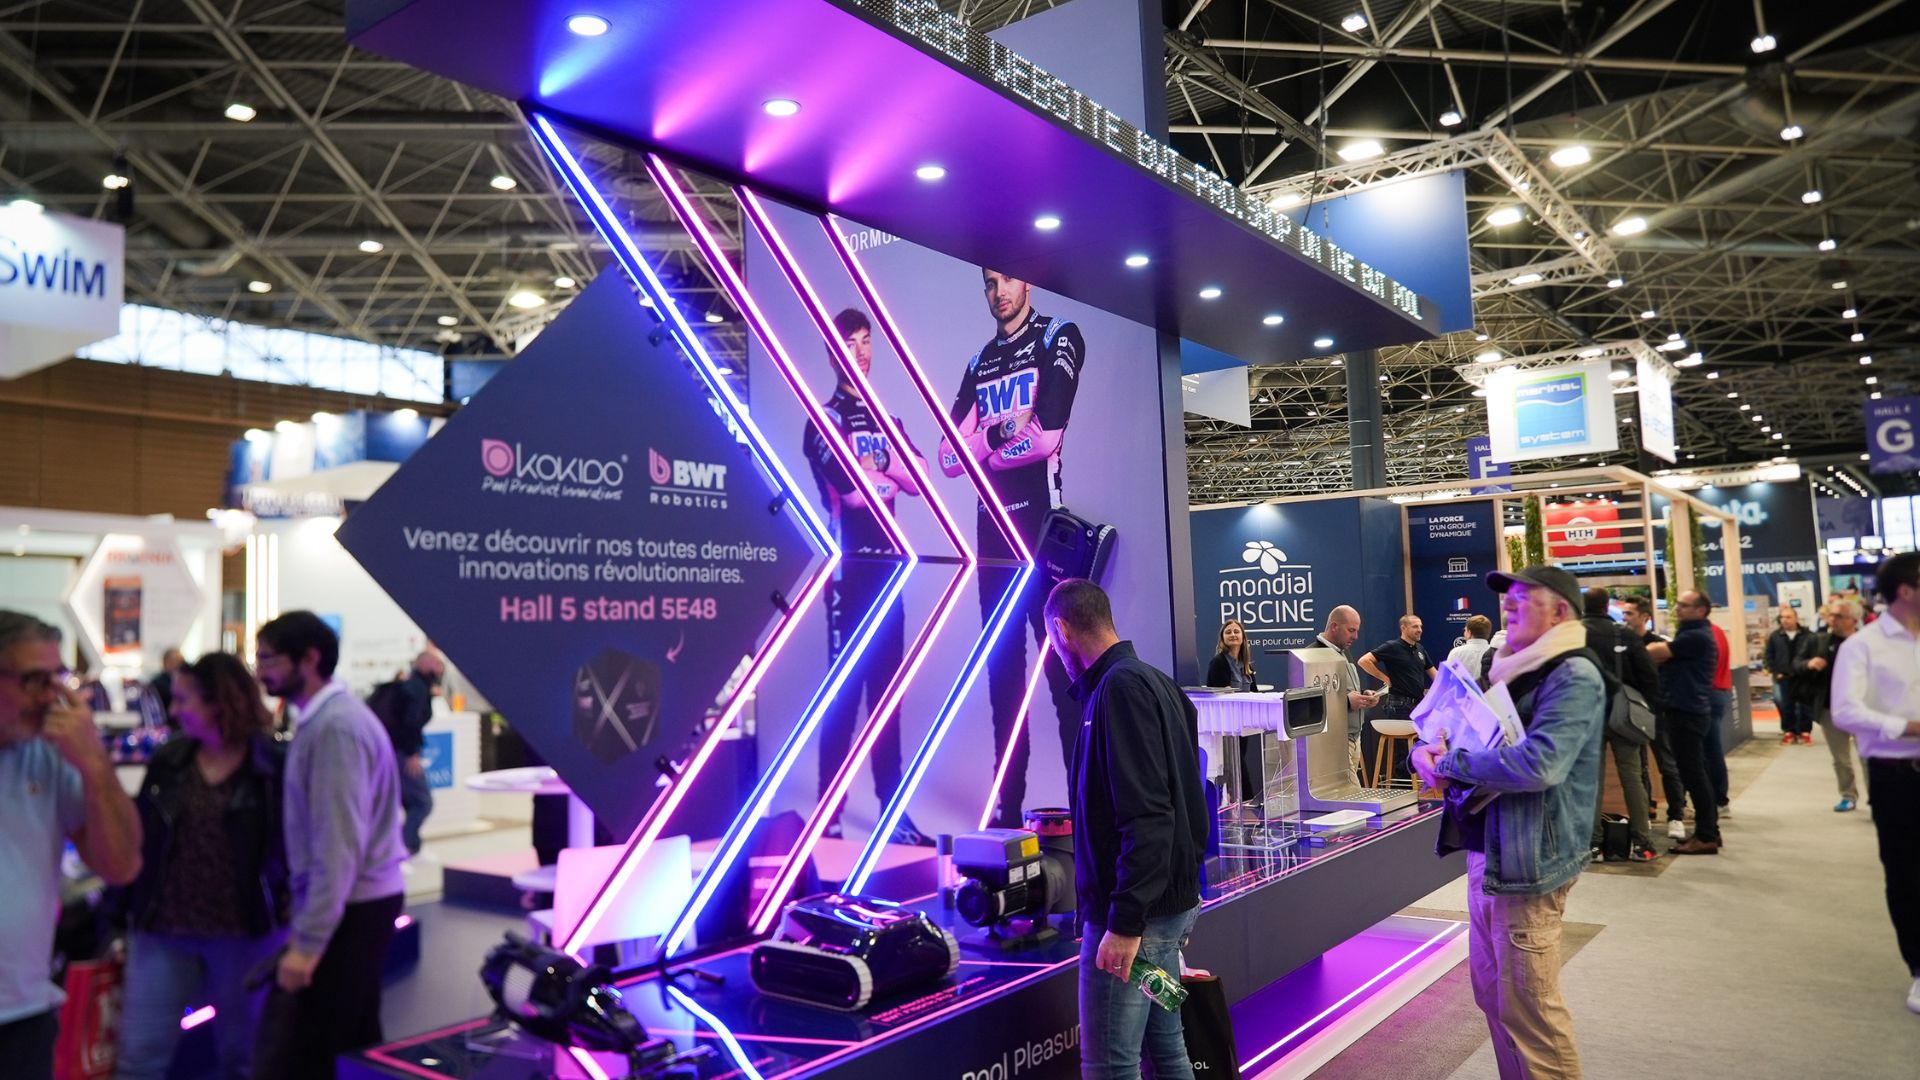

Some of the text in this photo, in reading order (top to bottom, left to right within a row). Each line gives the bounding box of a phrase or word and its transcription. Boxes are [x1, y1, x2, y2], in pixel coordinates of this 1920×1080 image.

[991, 39, 1122, 152] WEBSITE
[1300, 226, 1322, 263] ON
[1328, 242, 1356, 282] THE
[1361, 262, 1386, 298] BWT
[1392, 281, 1423, 320] POOL
[976, 372, 1035, 419] BWT
[1519, 428, 1585, 445] system
[1876, 418, 1914, 453] G
[1474, 444, 1492, 453] HAL
[673, 459, 727, 490] BWT
[650, 492, 728, 510] Robotics
[1004, 501, 1029, 513] STEBAN
[1429, 522, 1476, 532] D'UN GROUPE
[1430, 530, 1472, 539] DYNAMIQUE
[1568, 529, 1593, 538] HTH
[403, 526, 777, 563] Venez découvrir nos toutes dernières
[459, 554, 744, 584] innovations révolutionnaires.
[1756, 562, 1785, 573] OUR
[1786, 560, 1816, 572] DNA
[1220, 572, 1313, 597] mondial
[501, 594, 718, 622] Hall 5 stand 5E48
[1220, 599, 1314, 624] PISCINE
[1262, 637, 1283, 647] pour
[1283, 637, 1305, 646] durer
[1014, 1023, 1081, 1076] Pleasur
